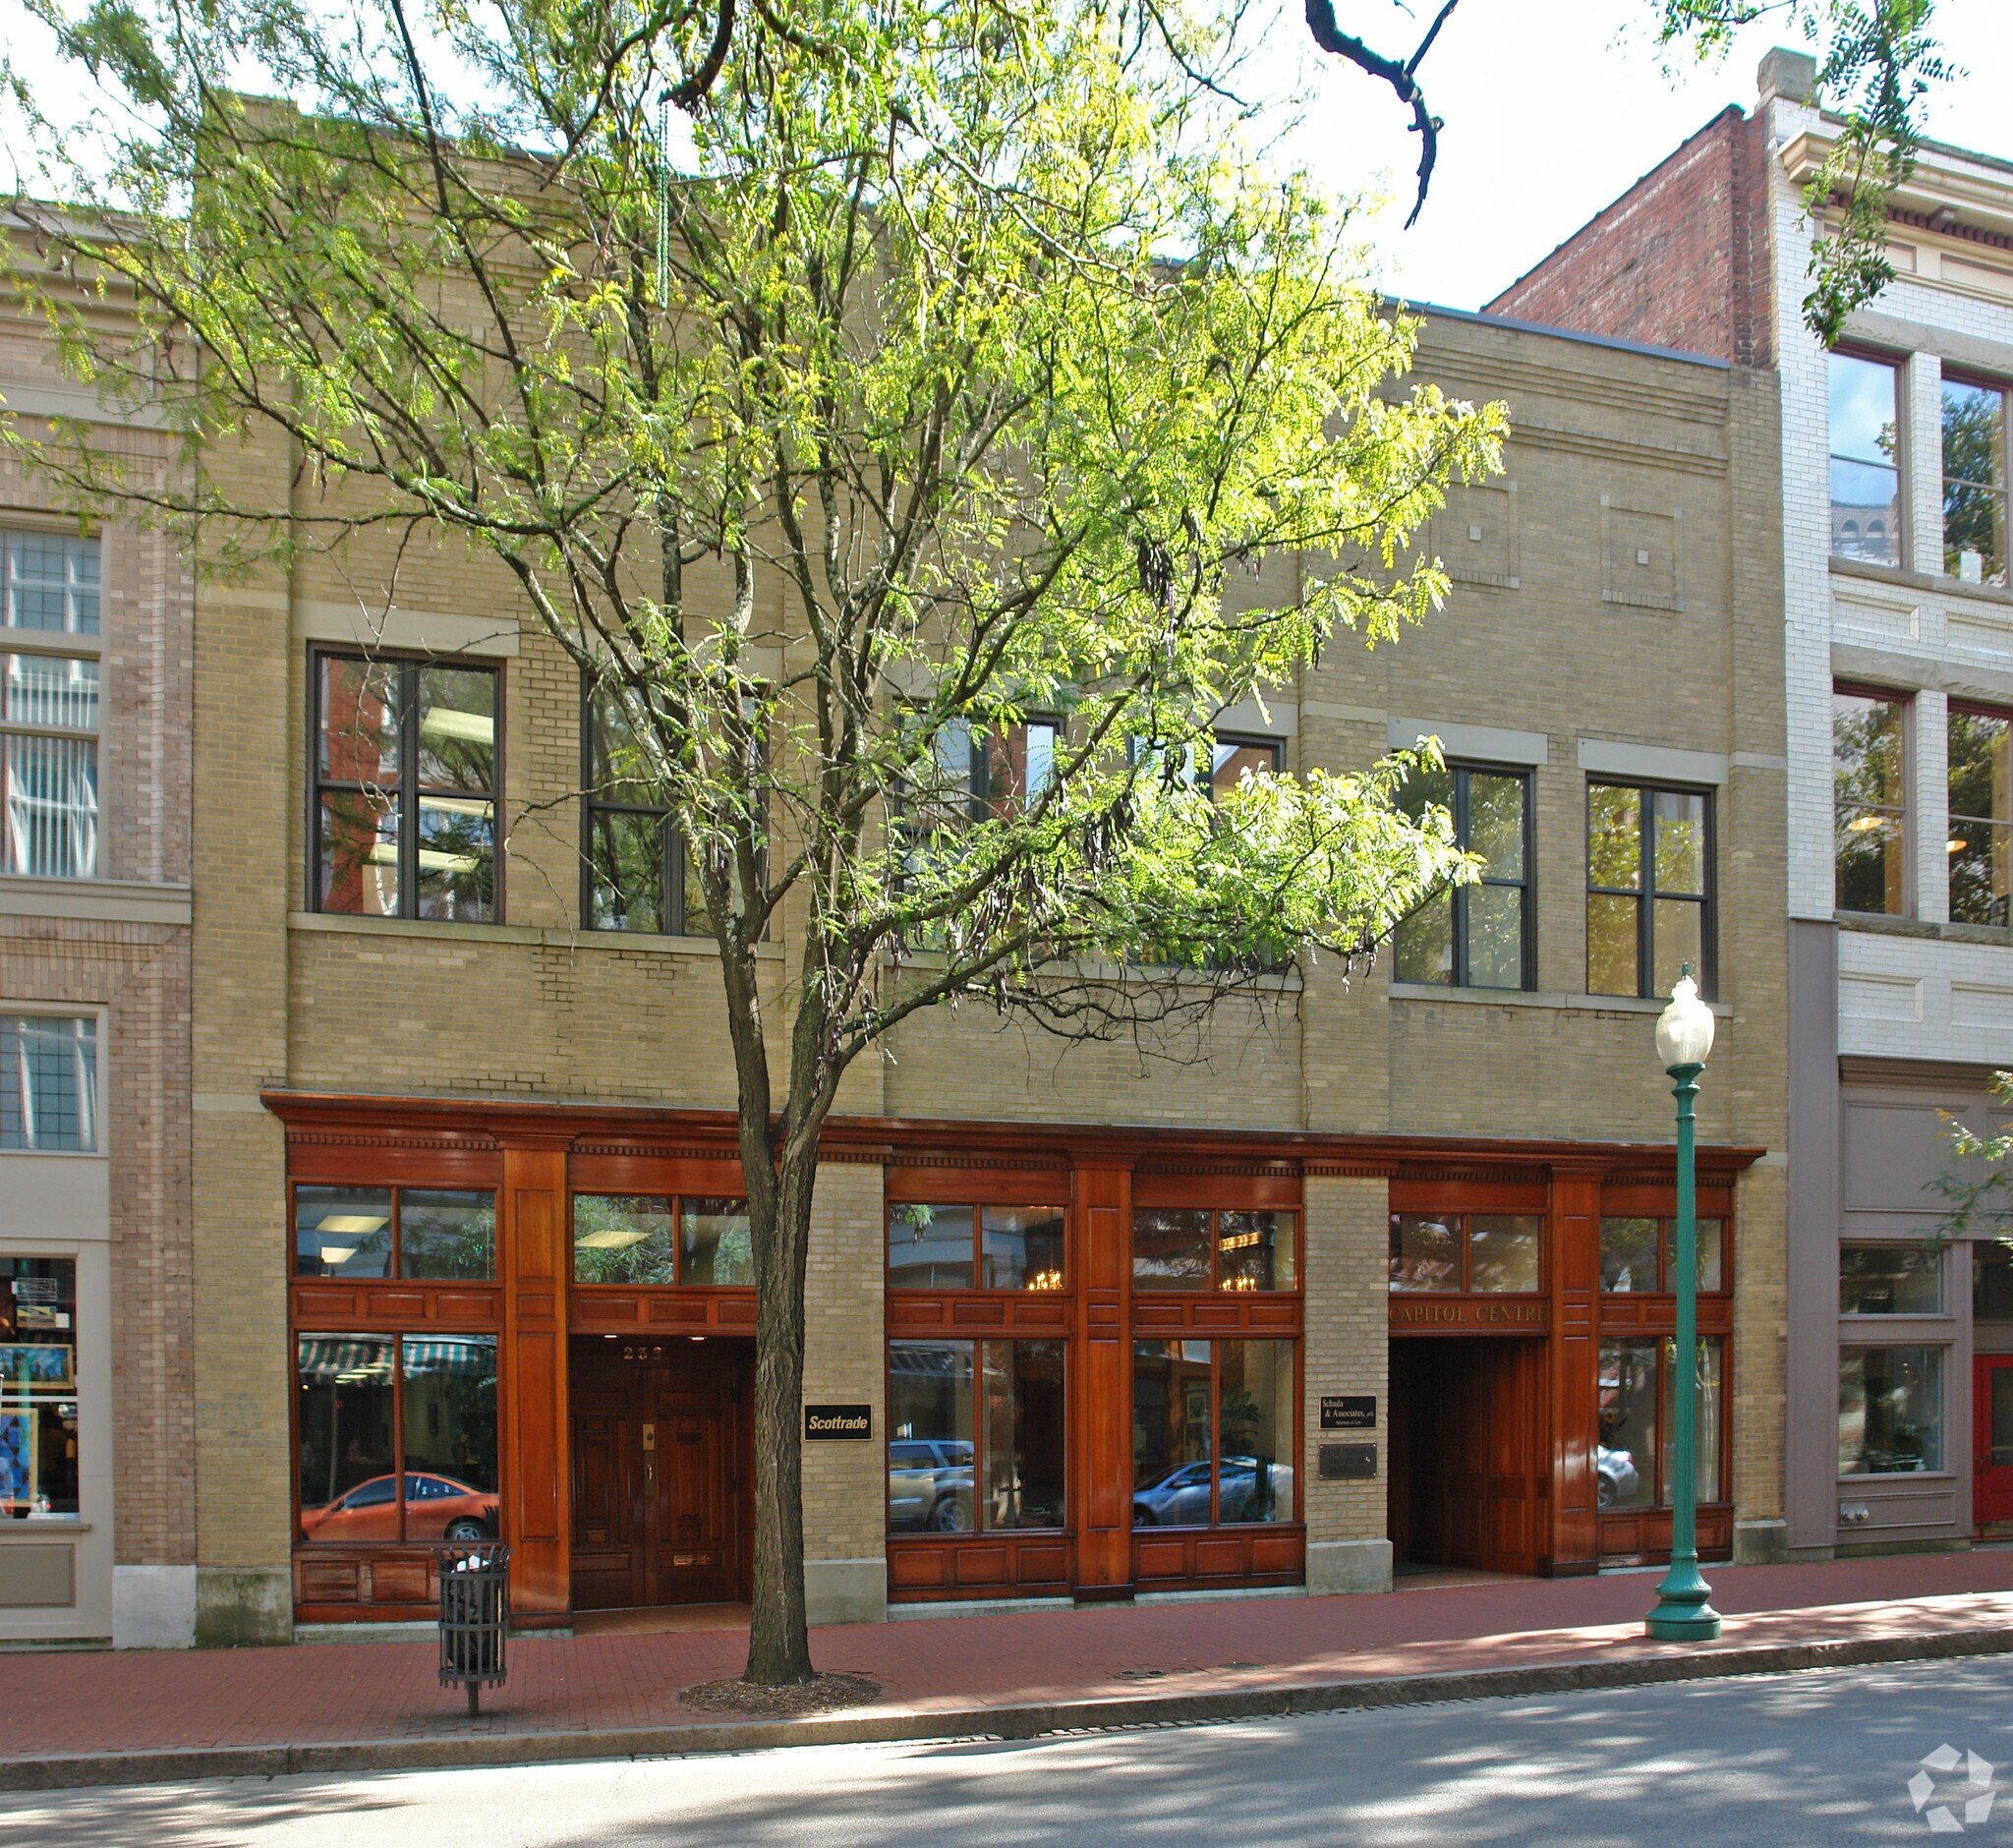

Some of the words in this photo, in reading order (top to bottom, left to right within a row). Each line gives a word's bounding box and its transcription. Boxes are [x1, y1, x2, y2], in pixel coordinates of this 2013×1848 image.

[1389, 1305, 1467, 1322] CAPITOL
[1475, 1305, 1546, 1322] CENTRE
[808, 1415, 868, 1430] Scottrade
